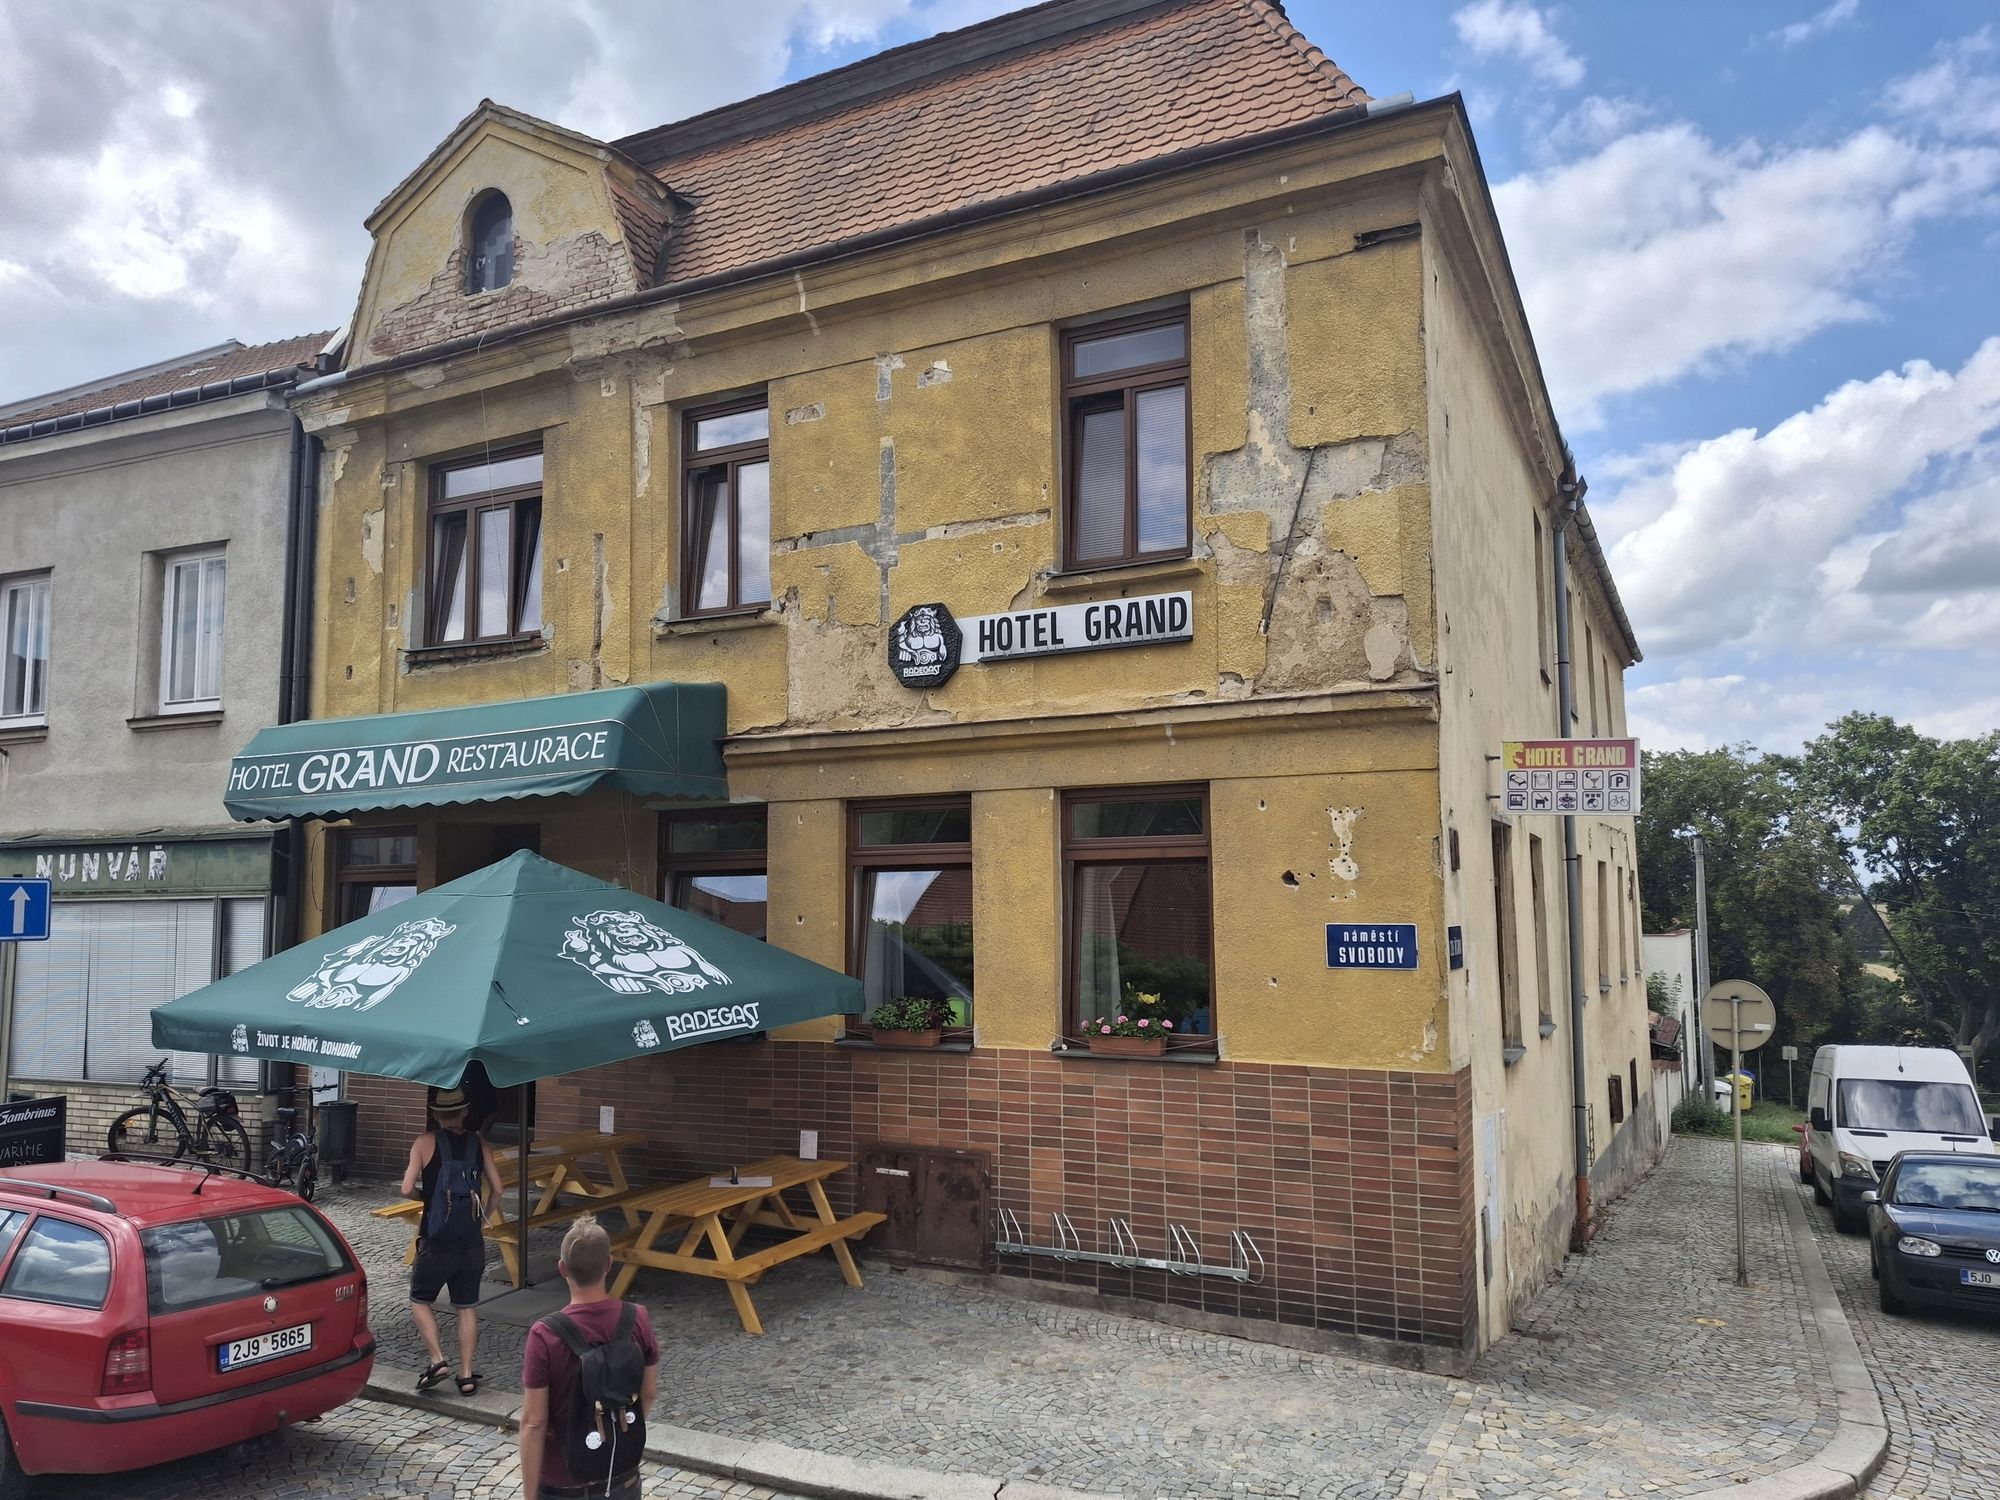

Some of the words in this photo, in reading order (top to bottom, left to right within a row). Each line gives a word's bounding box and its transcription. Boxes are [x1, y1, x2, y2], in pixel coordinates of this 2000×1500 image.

[978, 611, 1064, 653] HOTEL
[1084, 595, 1188, 642] GRAND
[903, 664, 942, 678] RADEGAST
[228, 763, 293, 791] HOTEL
[297, 743, 440, 794] GRAND
[446, 731, 609, 774] RESTAURACE
[1525, 747, 1567, 767] HOTEL
[1572, 746, 1627, 767] GRAND
[35, 845, 168, 882] NUNVÁŘ
[1343, 929, 1400, 943] náměstí
[1338, 946, 1404, 964] SVOBODY
[665, 1002, 760, 1042] RADEGAST
[256, 1030, 279, 1048] ŽIVOT
[281, 1035, 290, 1049] JE
[320, 1040, 361, 1059] BOHUDÍK!
[0, 1107, 57, 1126] Gambrinus
[232, 1339, 260, 1362] 2J9
[271, 1327, 305, 1351] 5865
